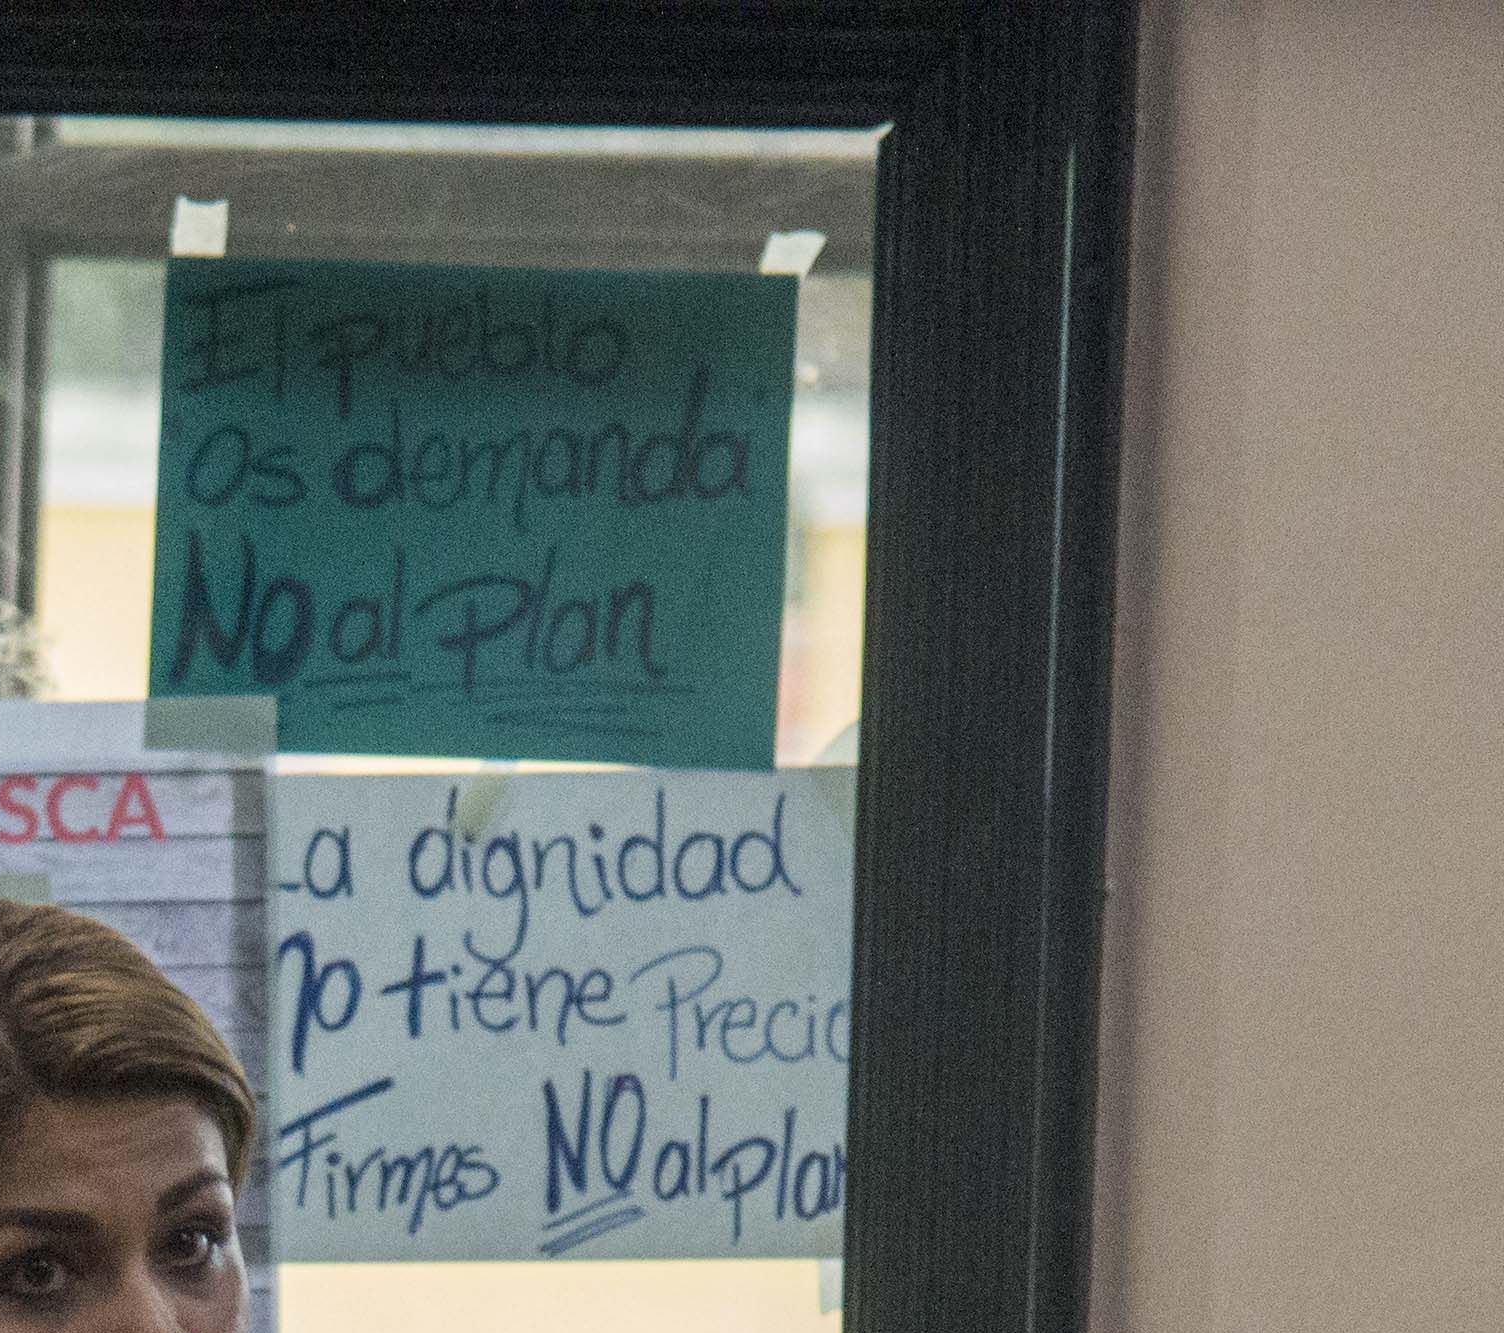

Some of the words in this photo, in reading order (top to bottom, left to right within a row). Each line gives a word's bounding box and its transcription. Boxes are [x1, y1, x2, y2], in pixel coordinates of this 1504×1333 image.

[187, 427, 307, 506] Os
[332, 365, 752, 533] demanda
[331, 544, 405, 662] al
[279, 827, 352, 899] a
[410, 786, 802, 963] dignidad
[381, 934, 627, 1046] tiene
[543, 1069, 646, 1214] NO
